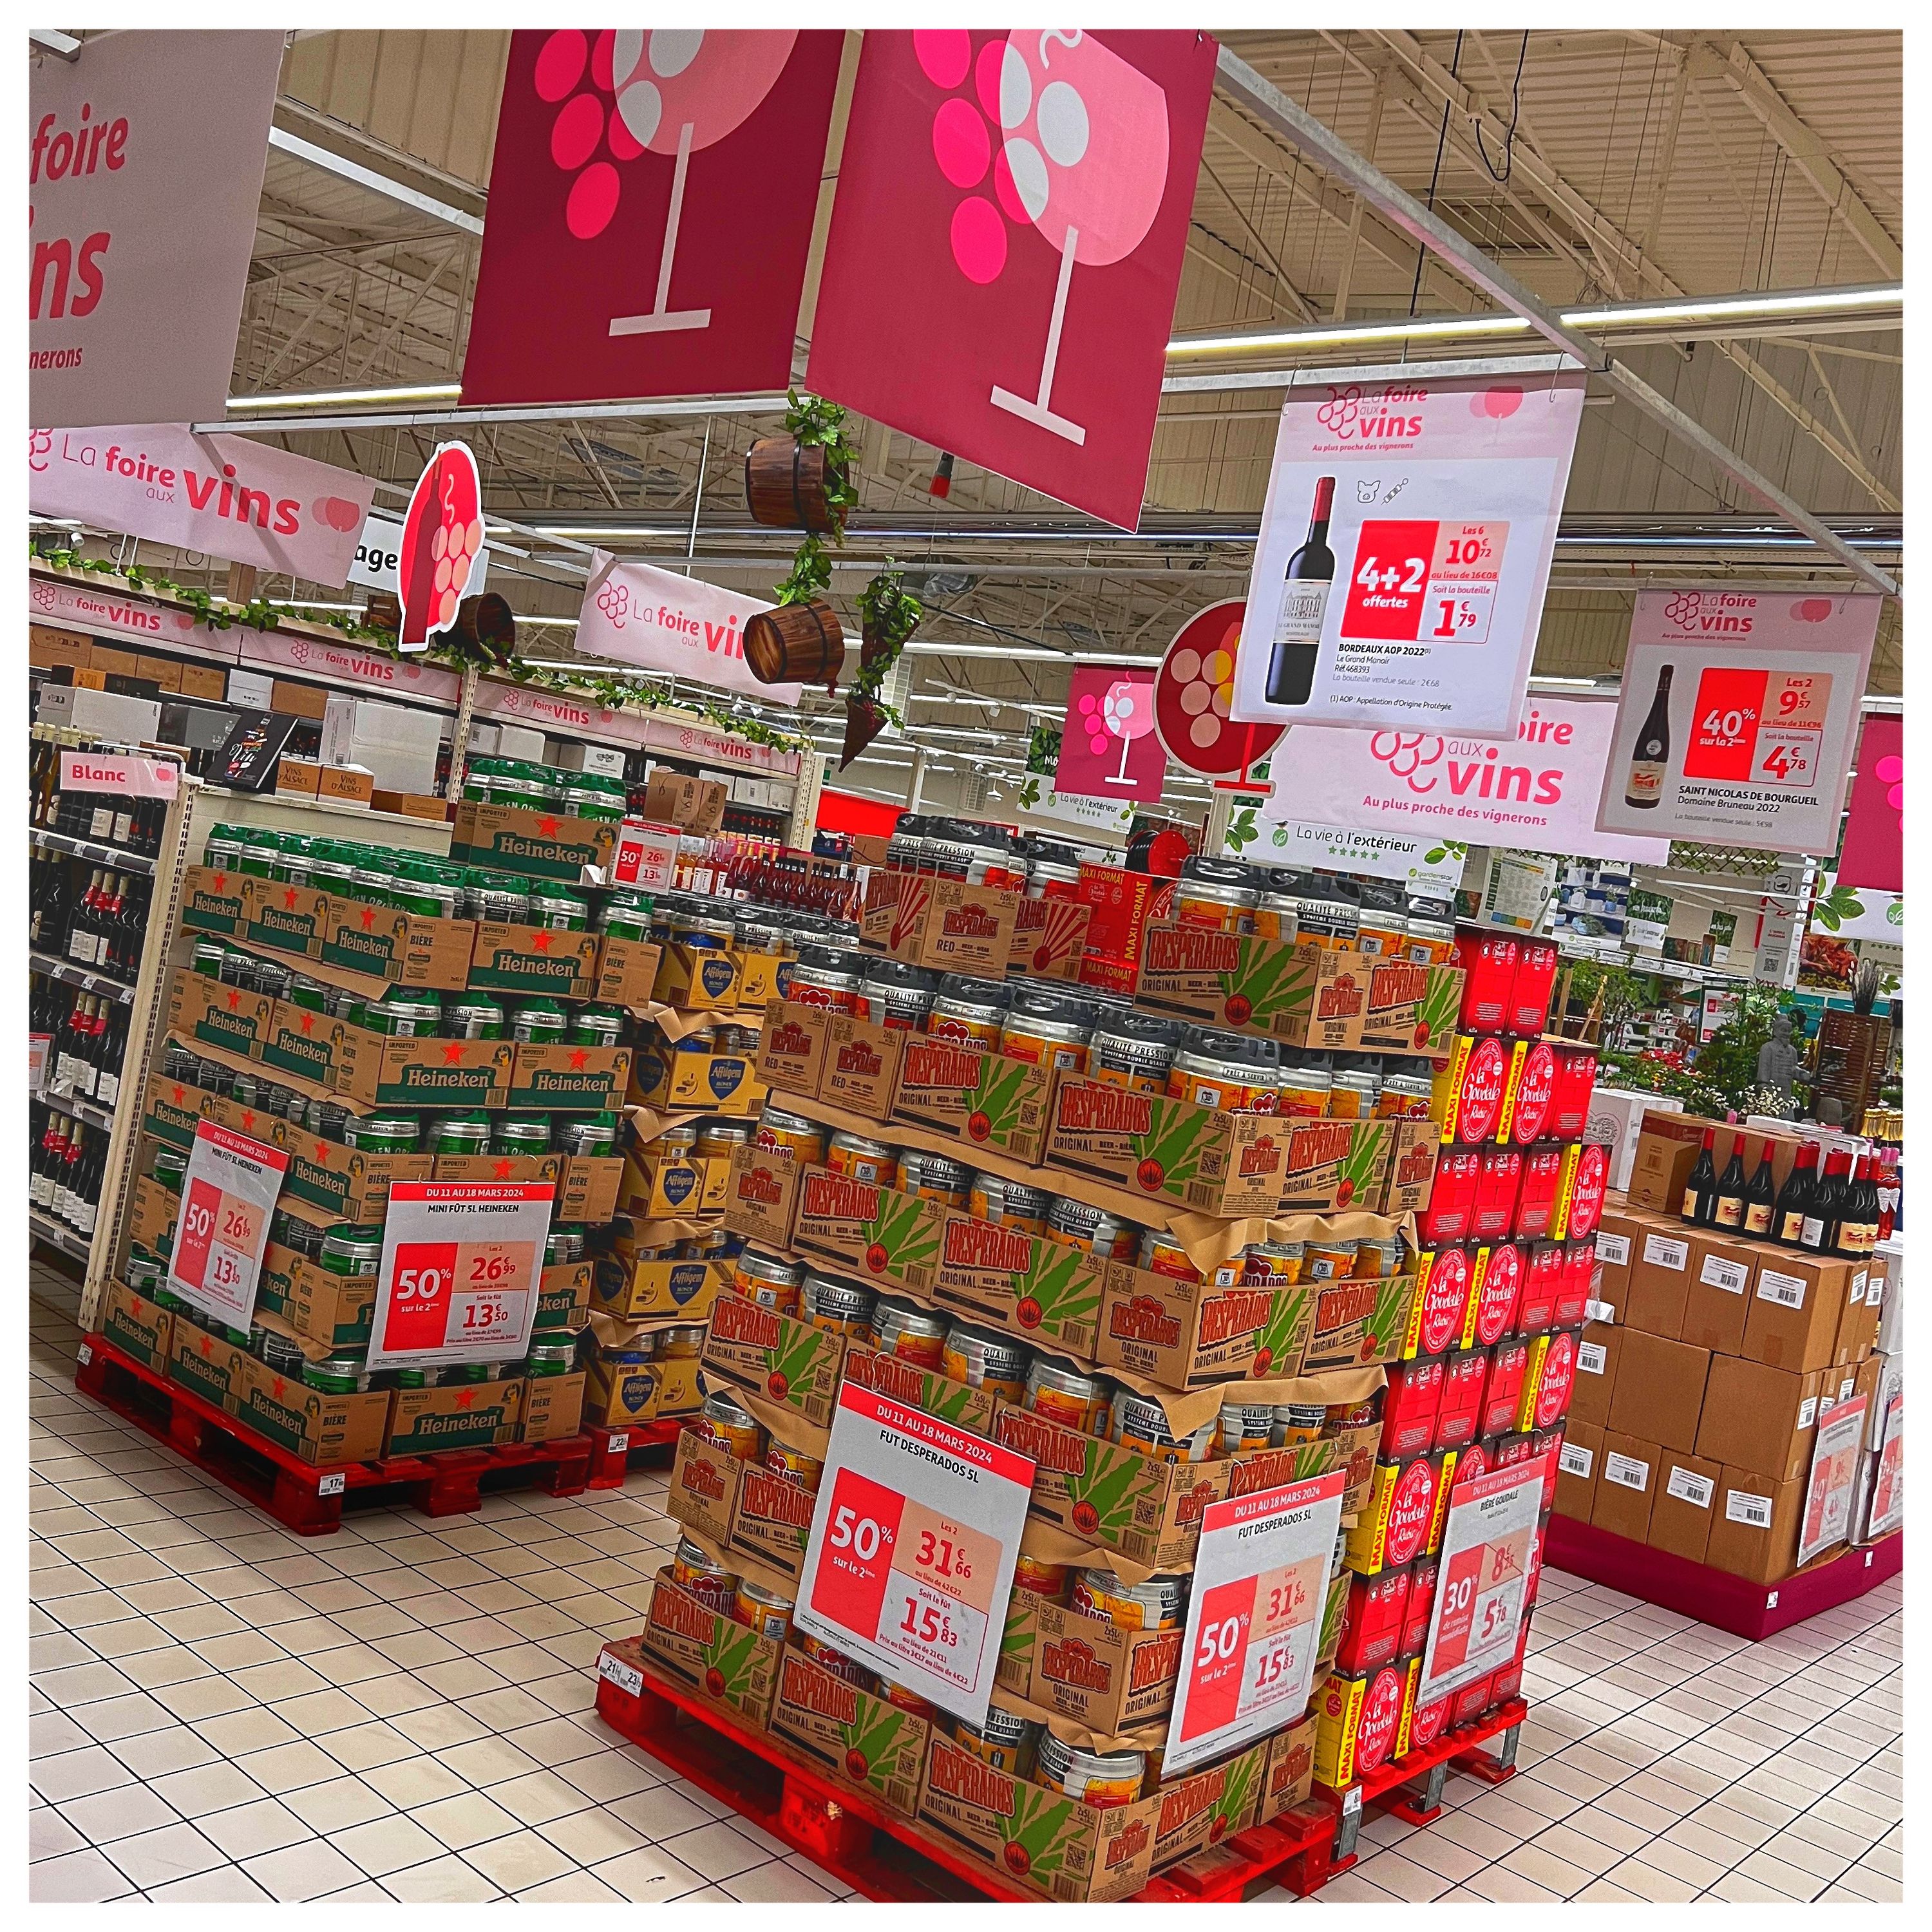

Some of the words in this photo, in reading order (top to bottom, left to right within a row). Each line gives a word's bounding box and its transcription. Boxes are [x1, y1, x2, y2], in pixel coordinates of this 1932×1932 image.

[29, 103, 128, 184] foire
[1361, 387, 1383, 404] La
[1385, 384, 1428, 401] foire
[1360, 404, 1378, 415] aux
[1360, 408, 1423, 438] vins
[62, 433, 96, 466] La
[105, 446, 176, 488] foire
[146, 486, 175, 504] aux
[183, 463, 301, 535] vins
[1463, 526, 1477, 535] Les
[1479, 526, 1484, 535] 6
[1357, 556, 1426, 594] 4+2
[1432, 585, 1446, 594] Soit
[1448, 585, 1455, 594] la
[1456, 586, 1490, 594] bouteille
[1363, 596, 1408, 609] offertes
[1702, 594, 1718, 607] La
[1720, 594, 1757, 608] foire
[59, 592, 73, 607] La
[76, 596, 106, 614] foire
[108, 602, 160, 631] vins
[634, 598, 652, 623] La
[658, 607, 699, 638] foire
[1701, 610, 1753, 632] vins
[681, 636, 699, 649] aux
[1339, 644, 1382, 654] BORDEAUX
[1383, 645, 1401, 655] AOP
[325, 652, 349, 667] foire
[350, 654, 394, 681] vins
[1367, 656, 1389, 665] Manoir
[1786, 677, 1803, 687] Les
[1804, 679, 1812, 687] 2
[1356, 697, 1392, 706] Appellation
[1394, 699, 1421, 708] d'Origine
[704, 736, 720, 749] foire
[721, 737, 752, 760] vins
[1448, 741, 1483, 756] aux
[1700, 737, 1714, 746] sur
[1716, 737, 1726, 746] la
[71, 764, 126, 782] Blanc
[341, 775, 356, 785] VINS
[1448, 748, 1564, 804] vins
[1061, 793, 1068, 802] La
[1085, 799, 1117, 813] l'extérieur
[1678, 797, 1716, 808] Domaine
[1718, 799, 1754, 811] Bruneau
[1757, 803, 1780, 813] 2022
[1679, 786, 1705, 796] SAINT
[1707, 788, 1748, 799] NICOLAS
[1750, 791, 1763, 800] DE
[1765, 792, 1819, 805] BOURGUEIL
[1363, 796, 1379, 806] Au
[1383, 799, 1409, 811] plus
[1412, 804, 1454, 815] proche
[1457, 806, 1479, 818] des
[1482, 810, 1547, 826] vignerons
[1297, 826, 1312, 838] La
[1315, 829, 1332, 841] vie
[1336, 831, 1342, 843] à
[1347, 832, 1417, 853] l'extérieur
[500, 838, 589, 865] Heineken
[1296, 902, 1332, 916] QUALITÉ
[1124, 928, 1139, 960] MAXI
[1132, 882, 1148, 924] FORMAT
[936, 939, 955, 952] RED
[1148, 926, 1241, 973] DESPERADOS
[498, 955, 574, 977] Heineken
[1141, 978, 1182, 992] ORIGINAL
[1133, 1043, 1173, 1061] PRESSION
[764, 1057, 779, 1069] RED
[905, 1041, 981, 1091] DESPERADOS
[1451, 1046, 1469, 1097] FORMAT
[406, 1068, 490, 1088] Heineken
[537, 1074, 609, 1092] Heineken
[1059, 1083, 1153, 1136] DESPERADOS
[1054, 1136, 1094, 1151] ORIGINAL
[920, 1159, 951, 1172] QUALITÉ
[569, 1176, 587, 1187] BIÈRE
[426, 1188, 439, 1197] DU
[450, 1203, 466, 1213] FÛT
[467, 1204, 477, 1213] 5L
[1063, 1203, 1102, 1221] PRESSION
[799, 1222, 831, 1238] ORIGINAL
[945, 1220, 1032, 1274] DESPERADOS
[672, 1271, 703, 1284] Affligem
[940, 1271, 977, 1289] ORIGINAL
[1425, 1283, 1464, 1312] Goudale
[1121, 1341, 1158, 1363] ORIGINAL
[625, 1381, 653, 1394] Affligem
[252, 1392, 302, 1434] Heineken
[1525, 1395, 1535, 1425] MAXI
[323, 1415, 346, 1426] BIÈRE
[420, 1415, 498, 1435] Heineken
[877, 1405, 892, 1419] DU
[892, 1412, 904, 1425] 11
[905, 1417, 921, 1432] AU
[922, 1424, 934, 1438] 18
[935, 1430, 964, 1452] MARS
[965, 1443, 992, 1464] 2024
[880, 1430, 900, 1446] FUT
[900, 1438, 966, 1477] DESPERADOS
[967, 1469, 978, 1484] 5L
[1378, 1477, 1396, 1527] FORMAT
[1388, 1500, 1430, 1528] Goudale
[1238, 1525, 1253, 1540] FUT
[1255, 1512, 1302, 1533] DESPERADOS
[1303, 1509, 1311, 1522] 5L
[833, 1556, 848, 1569] sur
[849, 1561, 858, 1575] le
[1398, 1719, 1409, 1752] MAXI
[929, 1740, 1016, 1817] DESPERADOS
